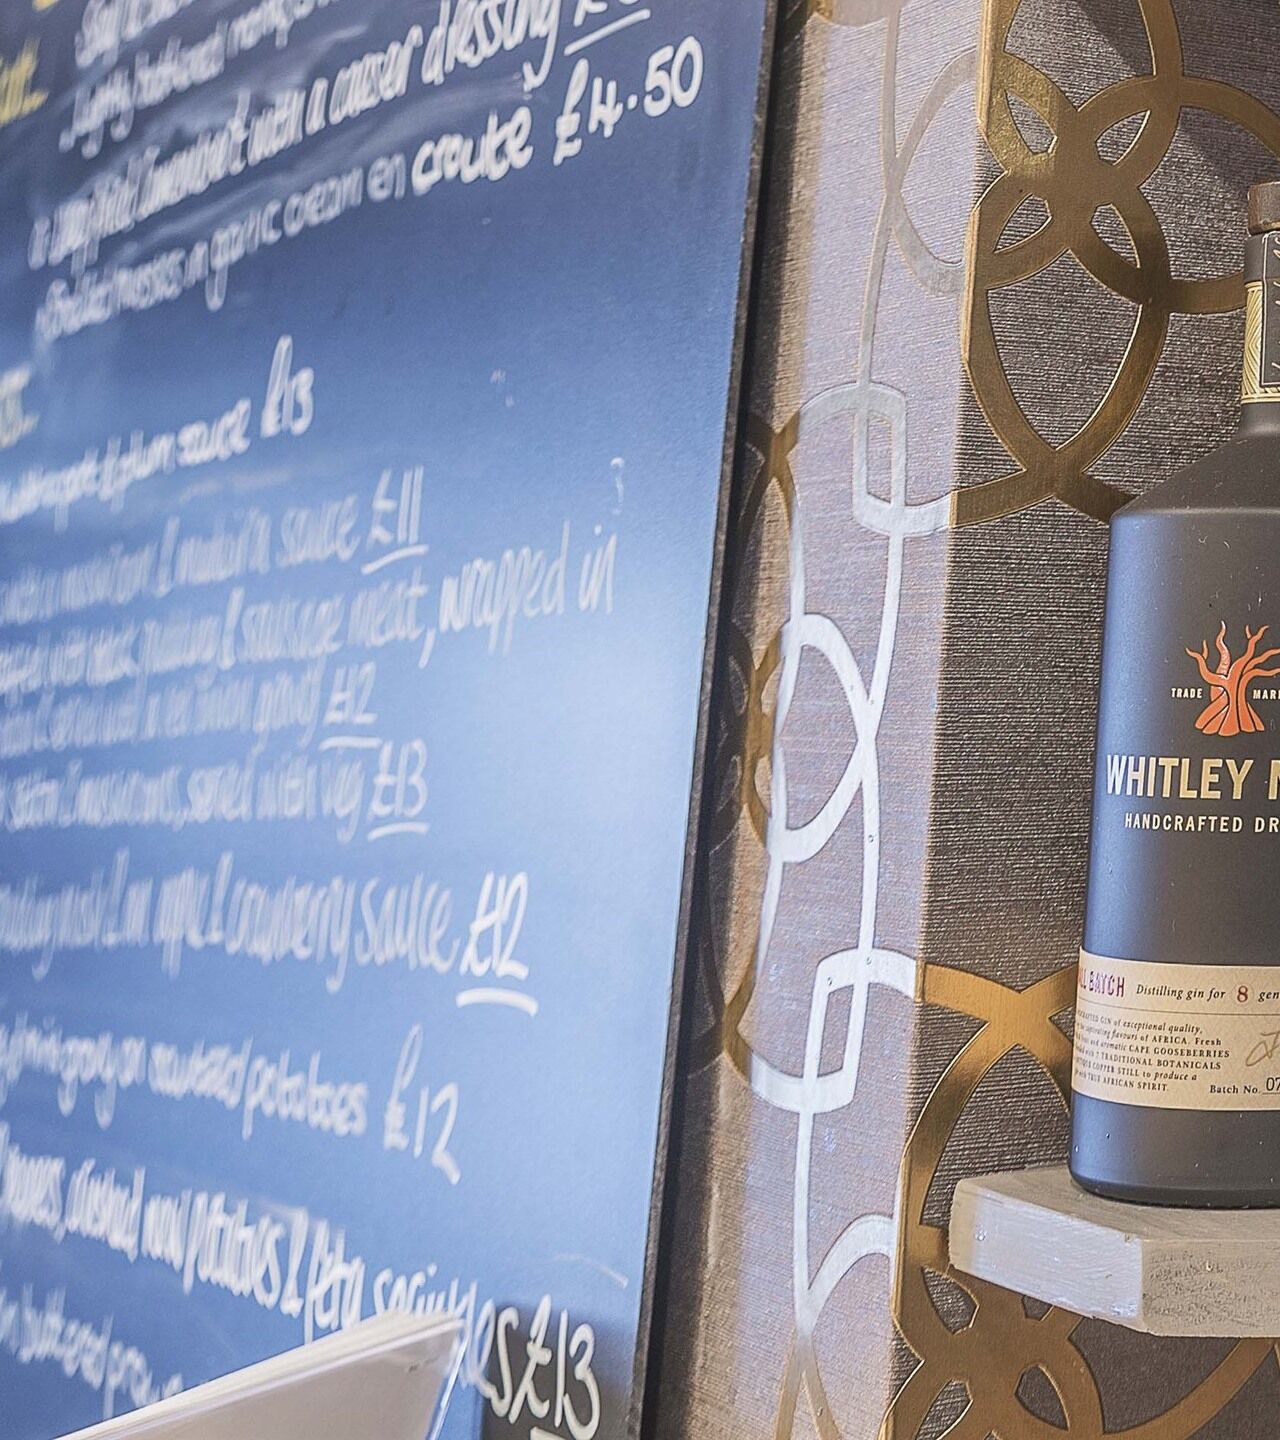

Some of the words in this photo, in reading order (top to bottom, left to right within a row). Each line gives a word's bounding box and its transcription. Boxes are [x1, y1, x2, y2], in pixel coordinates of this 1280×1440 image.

[554, 35, 704, 165] £4.50
[1170, 687, 1203, 700] TRADE
[1105, 753, 1254, 801] WHITLEY
[1124, 812, 1244, 833] HANDCRAFTED
[1135, 983, 1184, 1001] Distilling
[1186, 988, 1206, 1002] gin
[1208, 987, 1227, 1002] for
[1236, 985, 1250, 1003] 8
[1209, 1083, 1239, 1095] Batch
